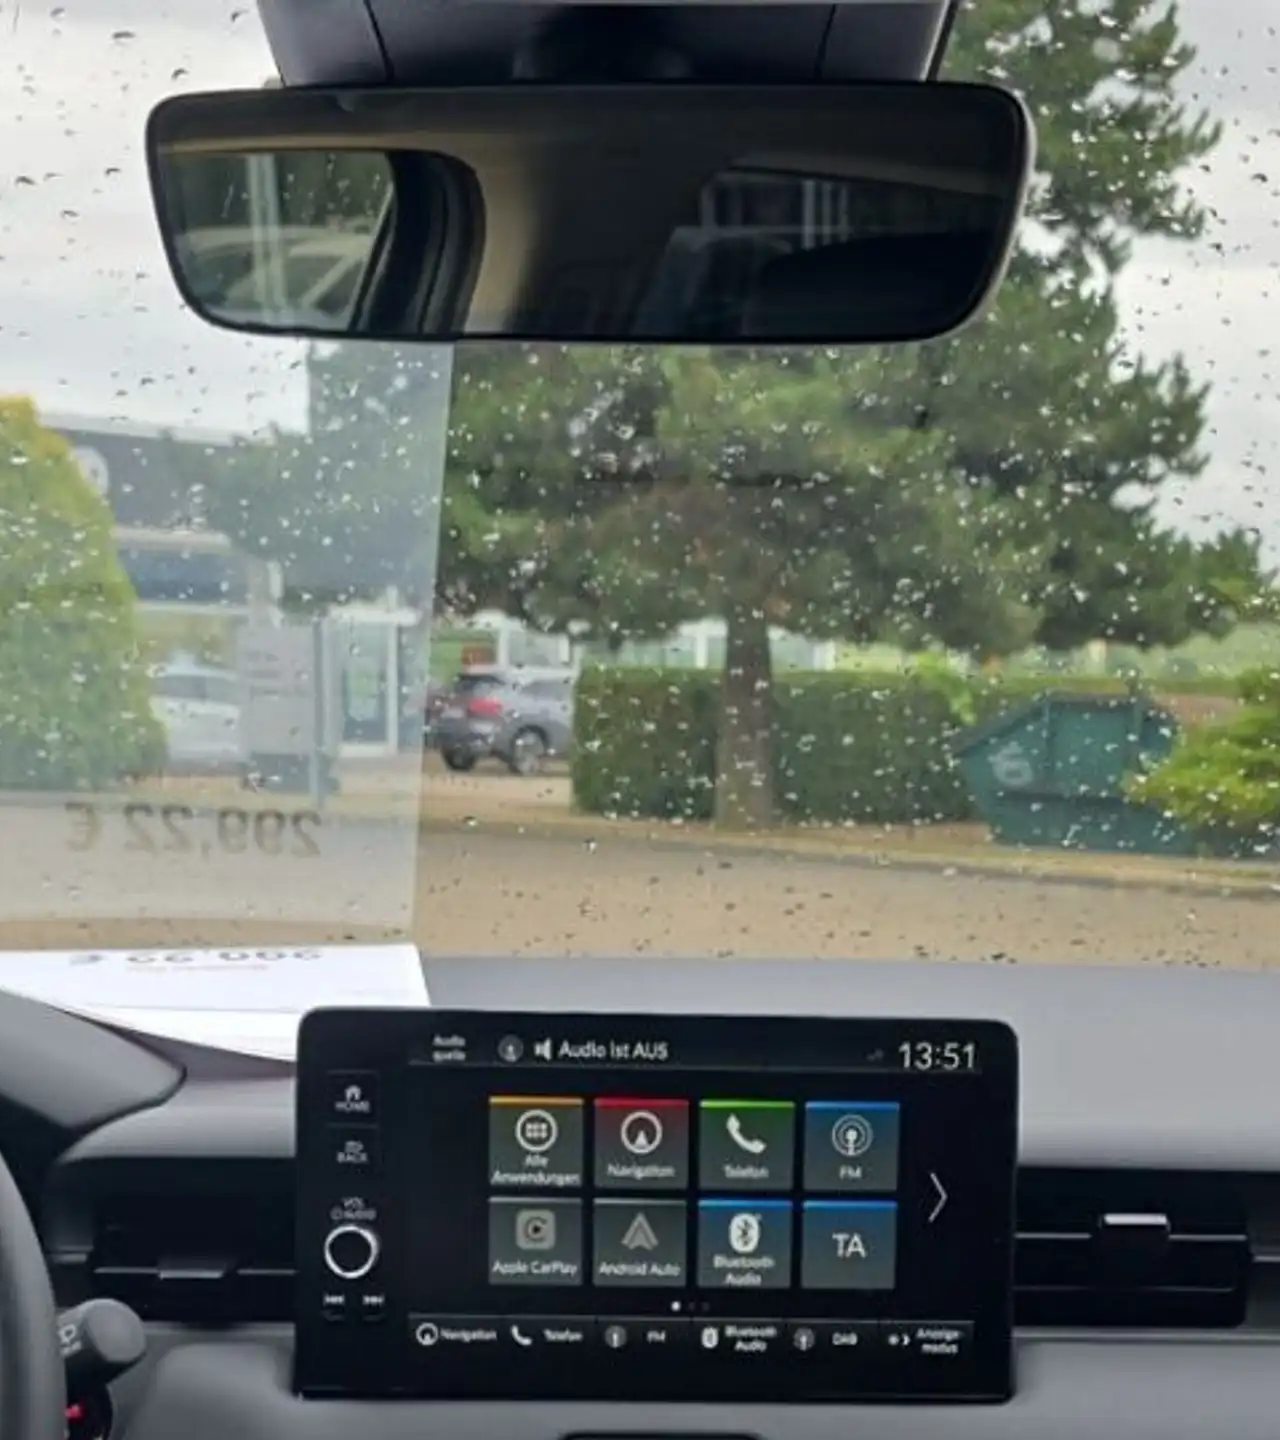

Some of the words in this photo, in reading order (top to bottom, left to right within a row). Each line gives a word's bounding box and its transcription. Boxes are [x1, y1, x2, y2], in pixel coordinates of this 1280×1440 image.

[557, 1040, 607, 1059] Audio
[632, 1042, 669, 1061] AUS
[898, 1041, 976, 1071] 13:51
[490, 1170, 580, 1187] Anwendungen
[606, 1164, 676, 1180] Navigation
[723, 1164, 769, 1179] Telefon
[838, 1165, 863, 1179] FM
[832, 1232, 868, 1259] TA
[492, 1260, 528, 1276] Apple
[530, 1260, 578, 1277] CarPlay
[598, 1261, 647, 1276] Android
[649, 1262, 681, 1276] Auto
[713, 1255, 776, 1269] Bluetooth
[725, 1271, 763, 1286] Audio
